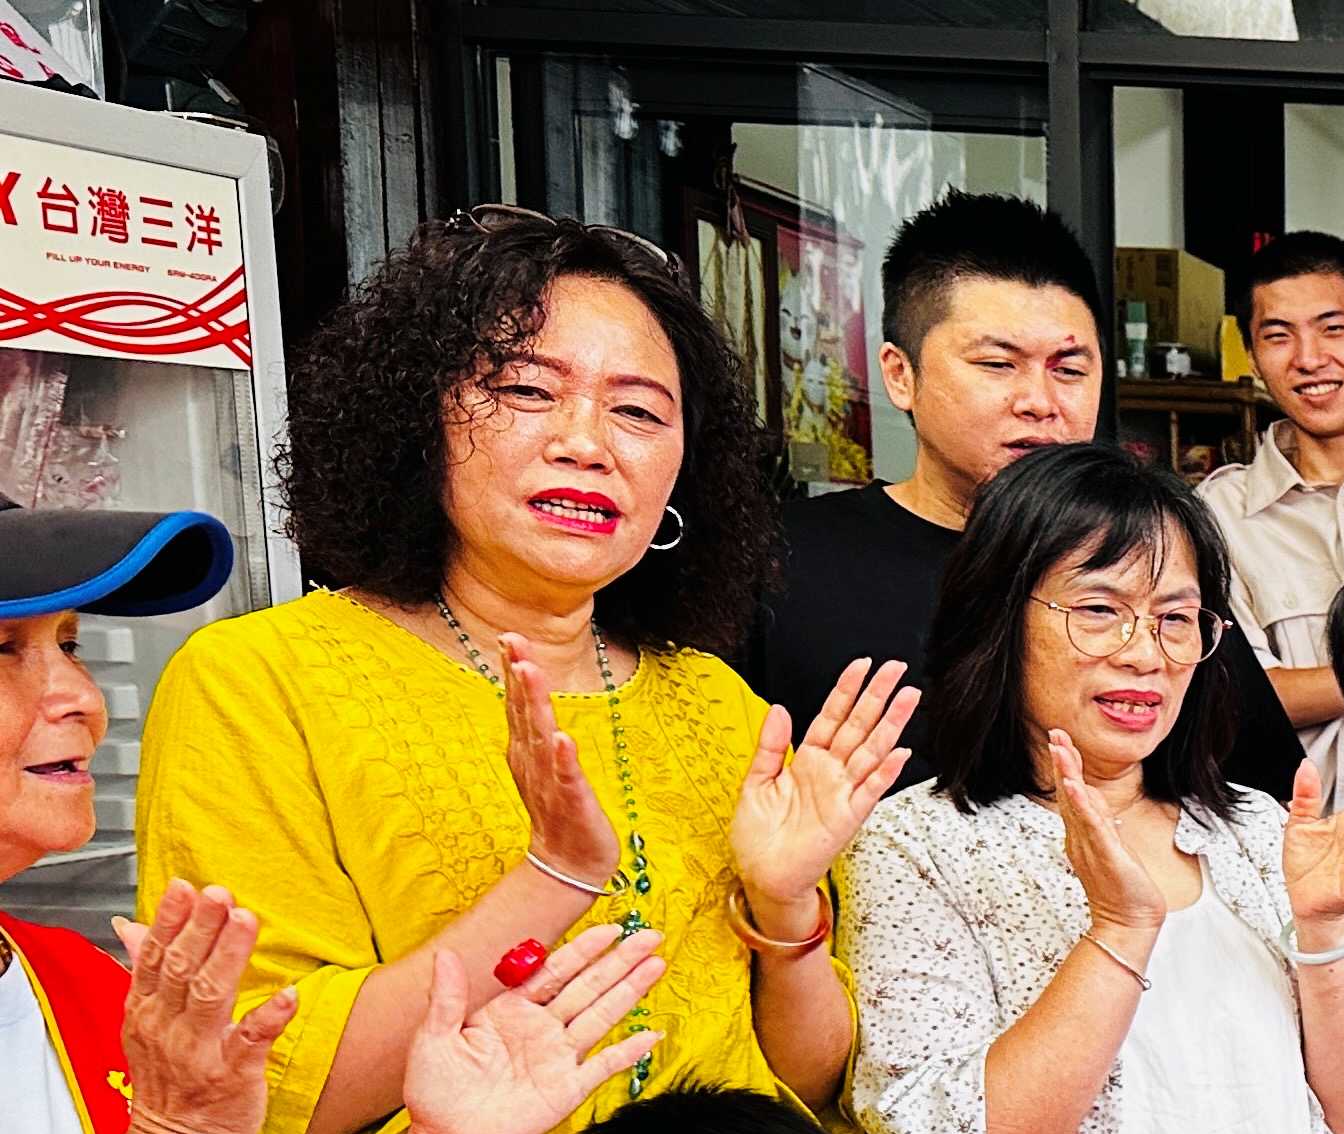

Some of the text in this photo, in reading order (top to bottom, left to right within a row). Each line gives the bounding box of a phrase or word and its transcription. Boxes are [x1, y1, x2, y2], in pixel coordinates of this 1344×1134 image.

[36, 176, 223, 256] 台灣三洋
[46, 252, 150, 272] FILL UP YOUR ENERGY
